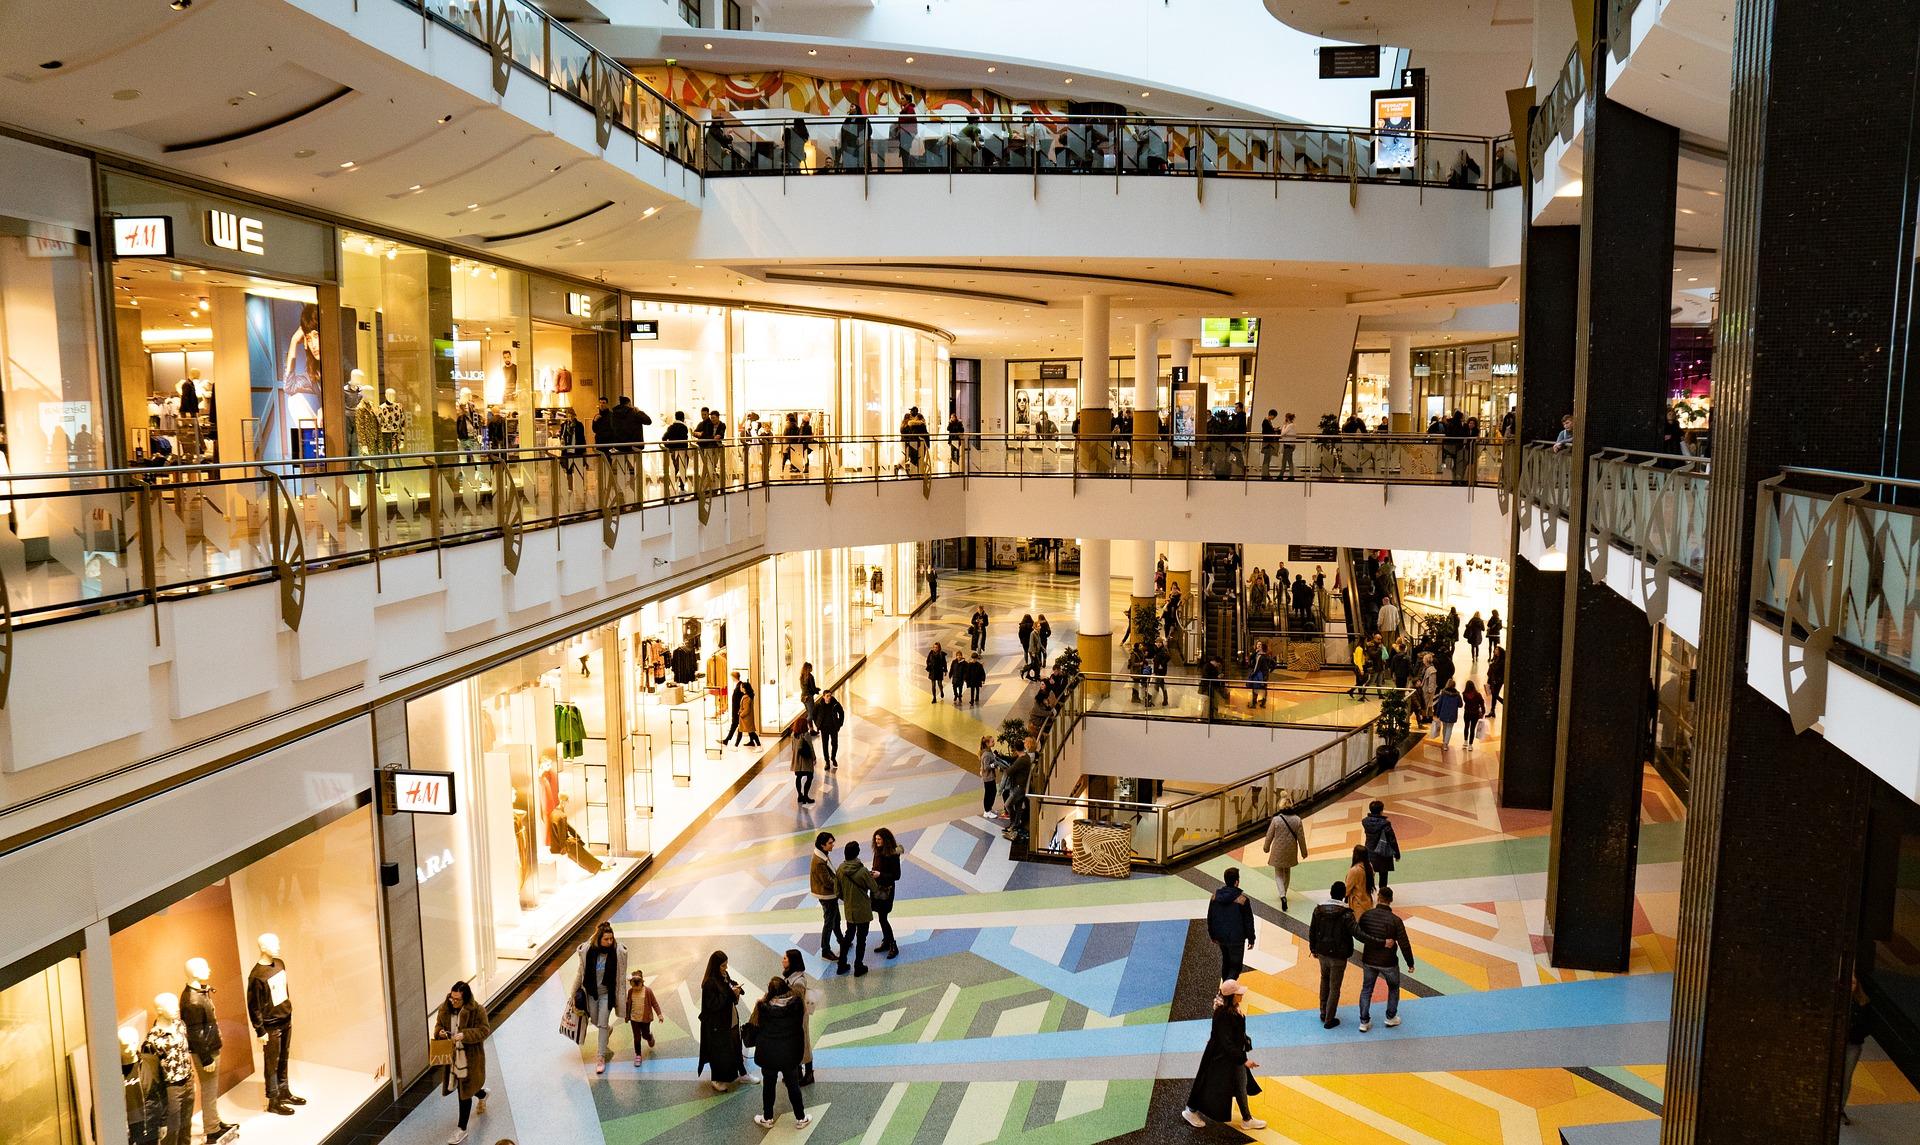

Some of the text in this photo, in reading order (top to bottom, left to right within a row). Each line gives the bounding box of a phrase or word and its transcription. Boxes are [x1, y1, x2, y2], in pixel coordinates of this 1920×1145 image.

[1403, 70, 1414, 87] i
[210, 209, 264, 256] WE
[569, 292, 591, 318] WE
[1178, 368, 1184, 381] i
[406, 781, 439, 805] H&M
